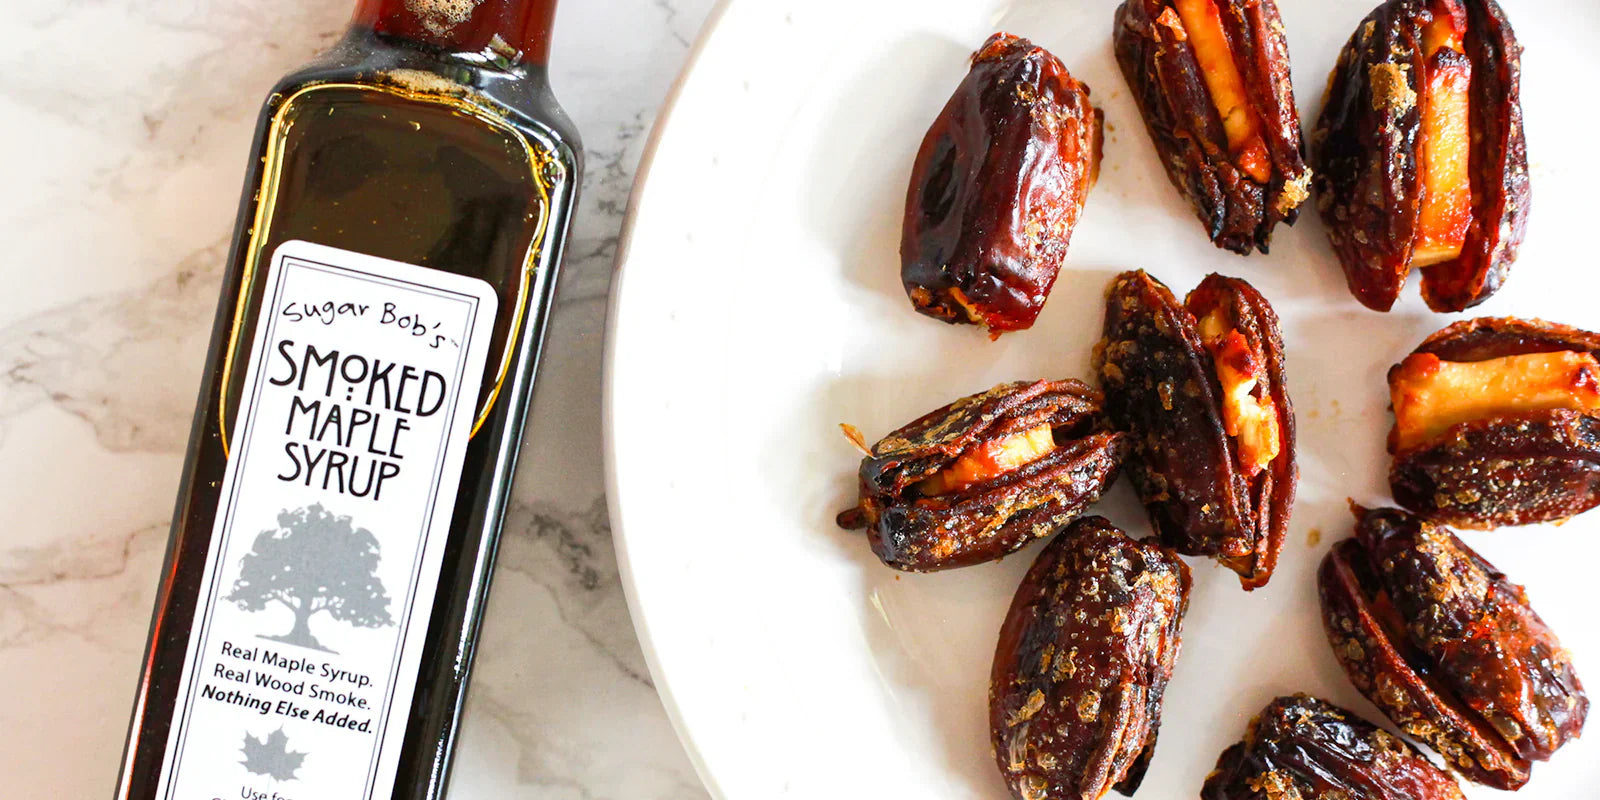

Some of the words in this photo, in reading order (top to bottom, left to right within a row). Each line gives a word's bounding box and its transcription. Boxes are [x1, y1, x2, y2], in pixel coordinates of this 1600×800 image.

[283, 301, 370, 325] Sugar
[380, 302, 446, 349] Bob's
[269, 340, 447, 417] SMOKED
[285, 395, 411, 459] MAPLE
[277, 442, 401, 501] SYRUP
[214, 663, 250, 683] Real
[255, 672, 305, 695] Wood
[309, 684, 371, 710] Smoke.
[221, 641, 258, 661] Real
[262, 651, 315, 674] Maple
[320, 663, 373, 688] Syrup.
[202, 684, 272, 715] Nothing
[275, 700, 310, 720] Else
[312, 709, 373, 734] Added.
[241, 786, 268, 800] Use
